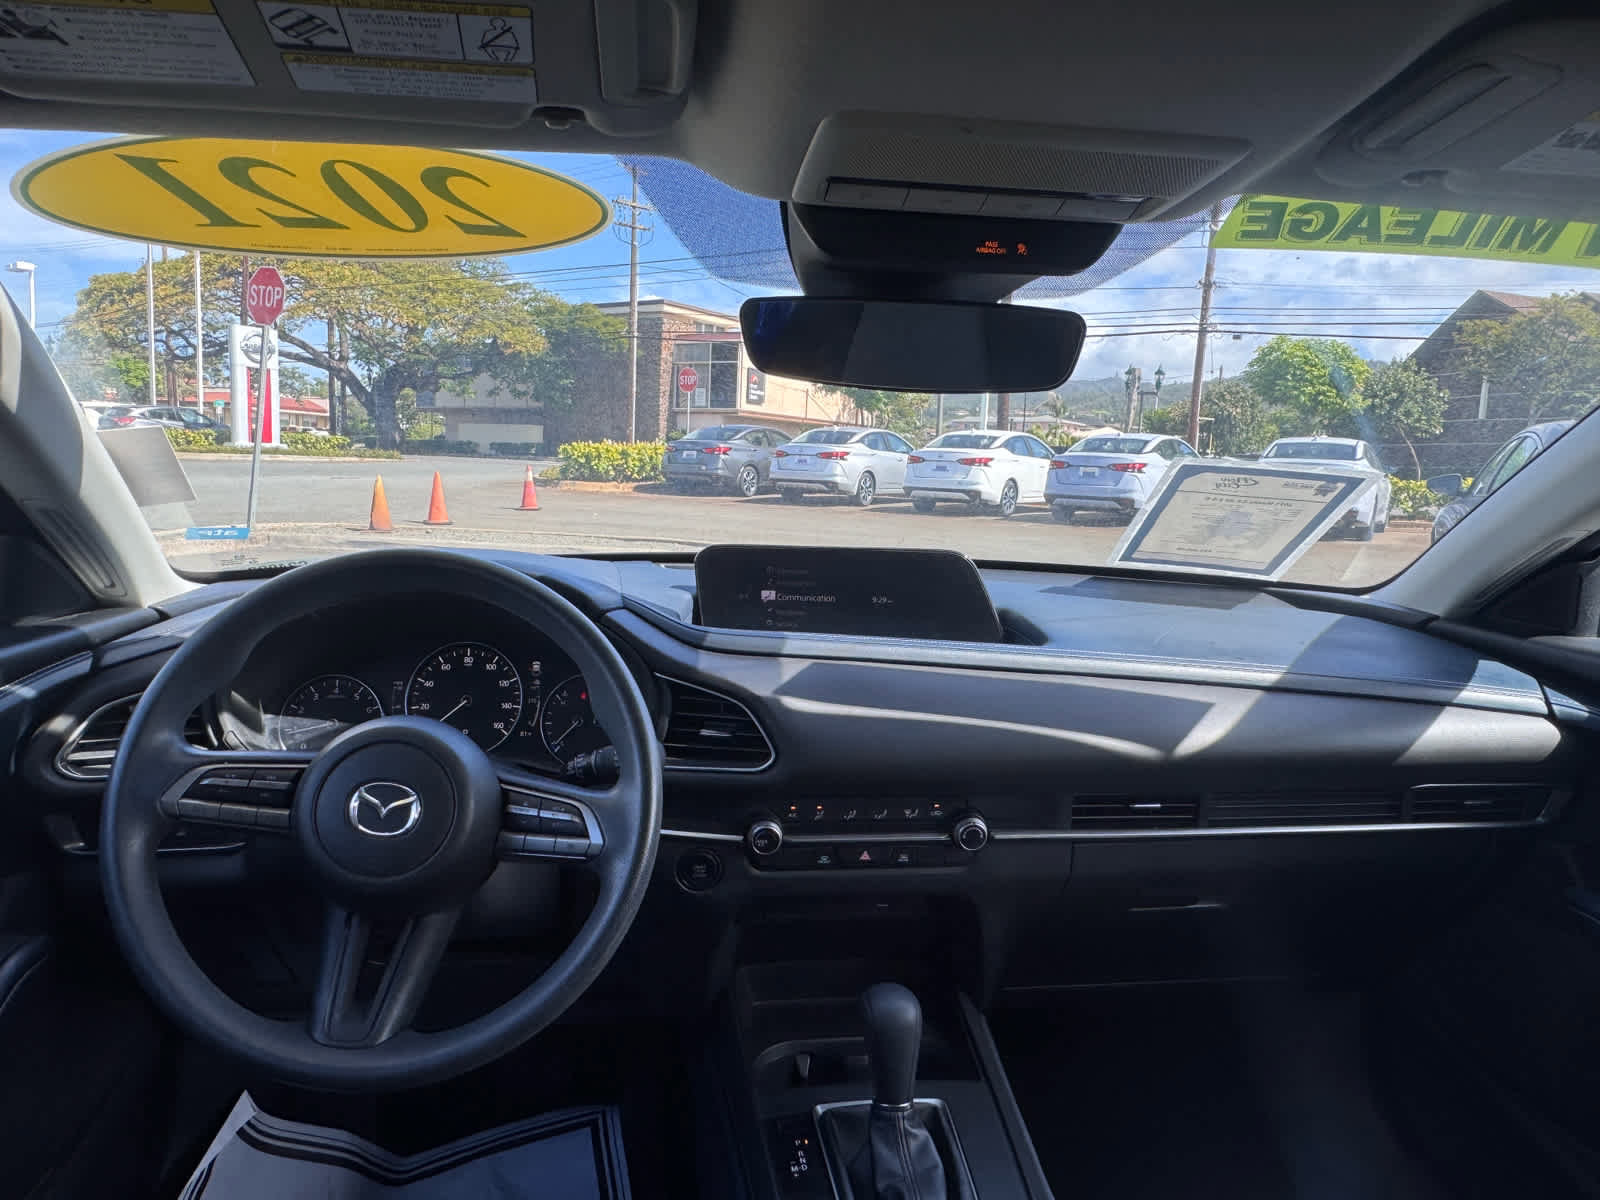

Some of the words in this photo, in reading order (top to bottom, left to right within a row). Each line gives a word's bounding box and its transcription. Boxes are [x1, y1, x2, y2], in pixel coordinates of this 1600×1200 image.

[250, 284, 282, 308] STOP
[680, 376, 696, 384] STOP
[776, 592, 836, 604] Communication
